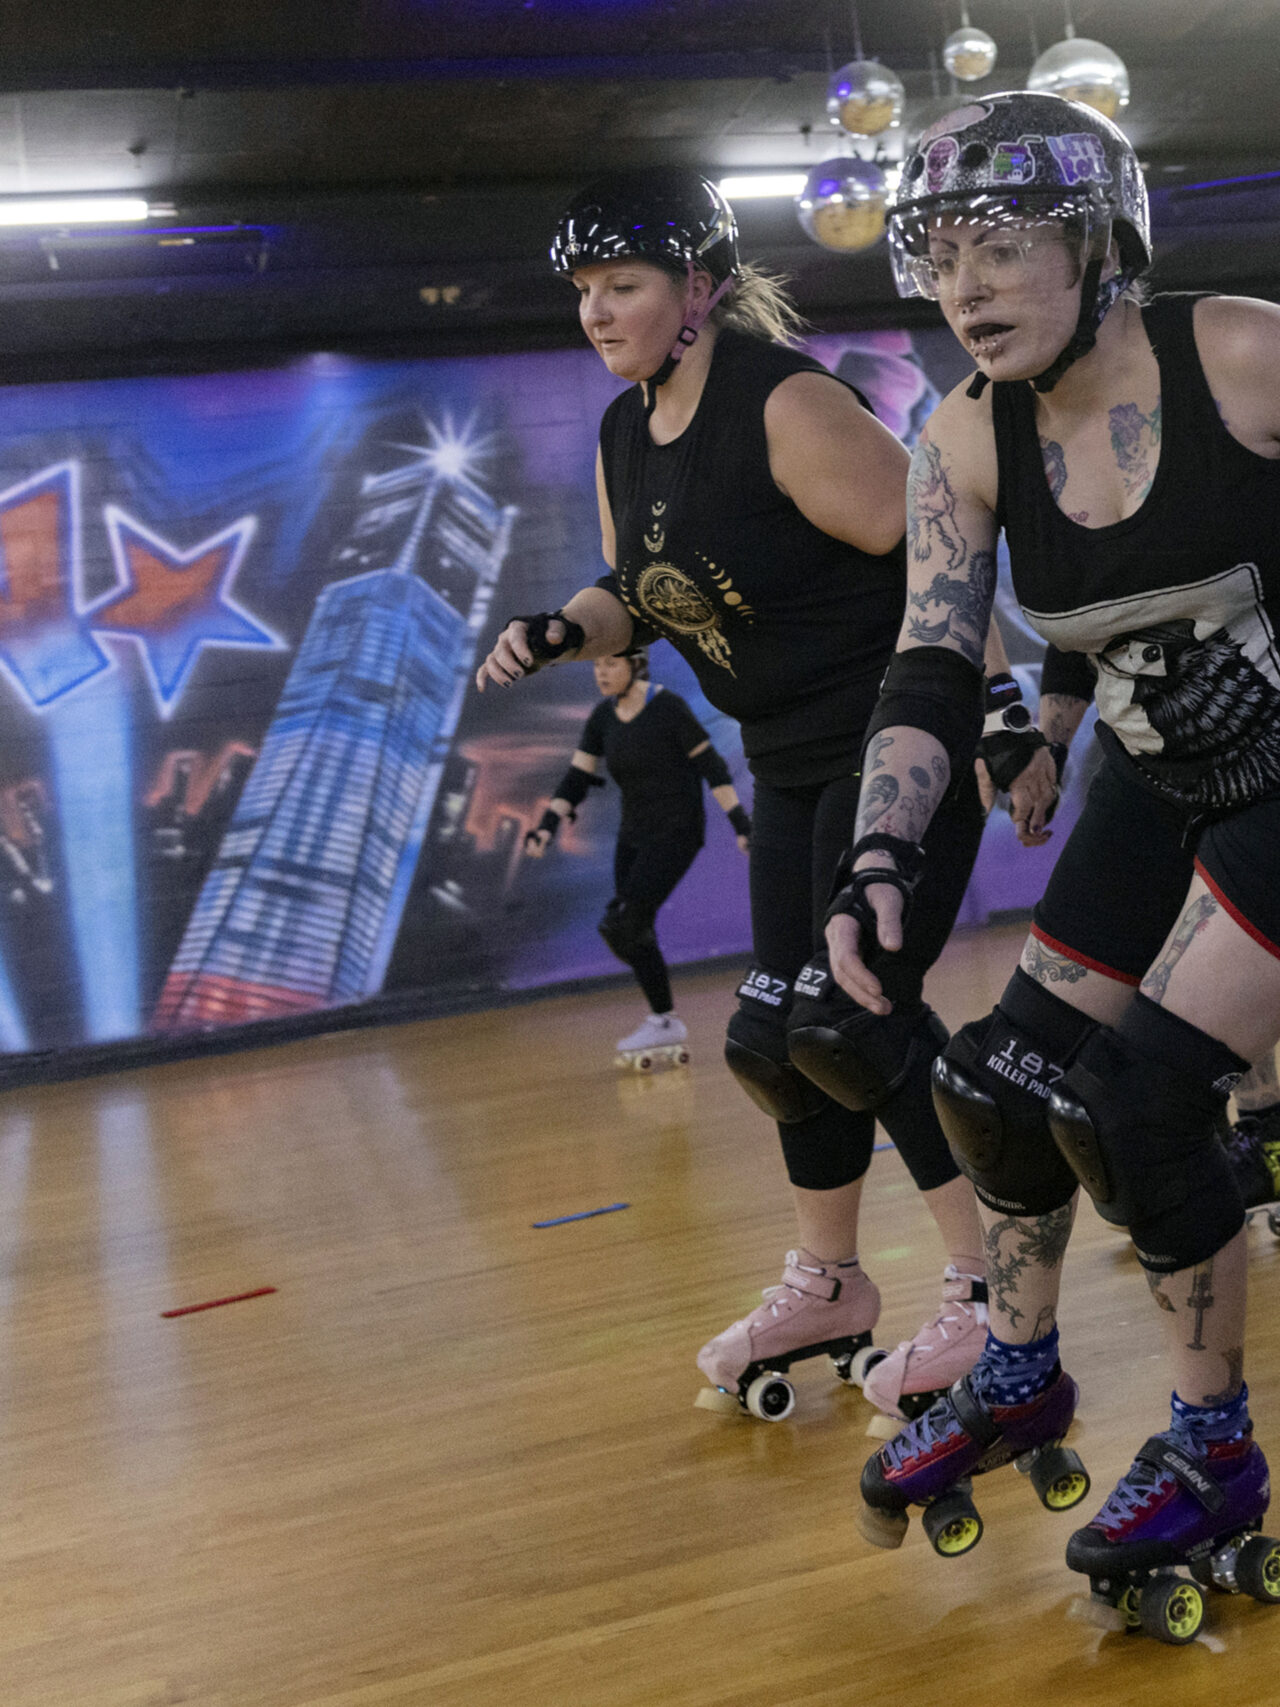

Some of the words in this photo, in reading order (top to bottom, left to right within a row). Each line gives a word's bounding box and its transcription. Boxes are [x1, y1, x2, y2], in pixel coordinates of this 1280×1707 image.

[1062, 156, 1113, 184] ROLL
[745, 968, 787, 994] 187
[800, 967, 828, 984] 87
[986, 1054, 1028, 1087] KILLER
[1026, 1079, 1052, 1099] PAD
[1000, 1039, 1064, 1084] 187
[1163, 1451, 1211, 1492] GEMINI
